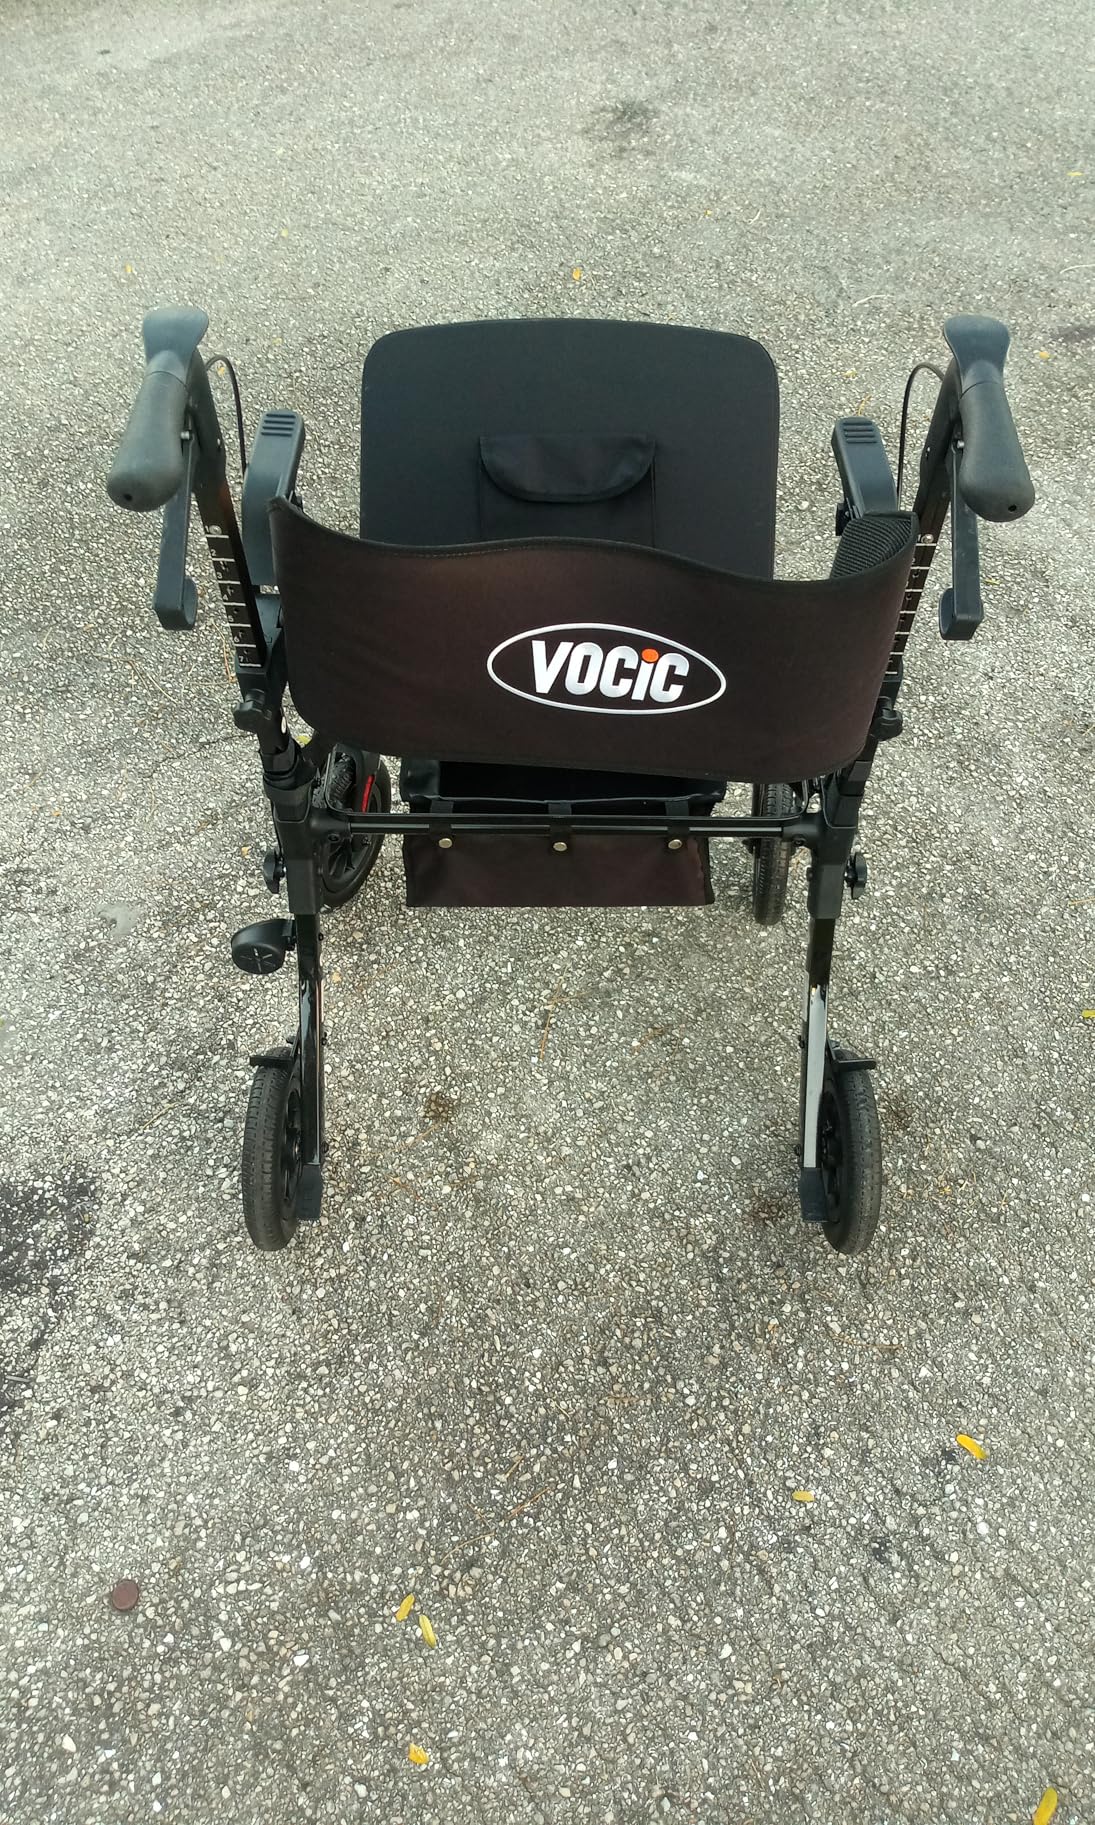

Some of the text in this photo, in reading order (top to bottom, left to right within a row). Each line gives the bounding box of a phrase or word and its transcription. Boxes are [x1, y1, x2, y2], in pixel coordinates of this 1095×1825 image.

[210, 549, 217, 557] 2
[222, 593, 229, 601] 4
[233, 635, 240, 643] 6
